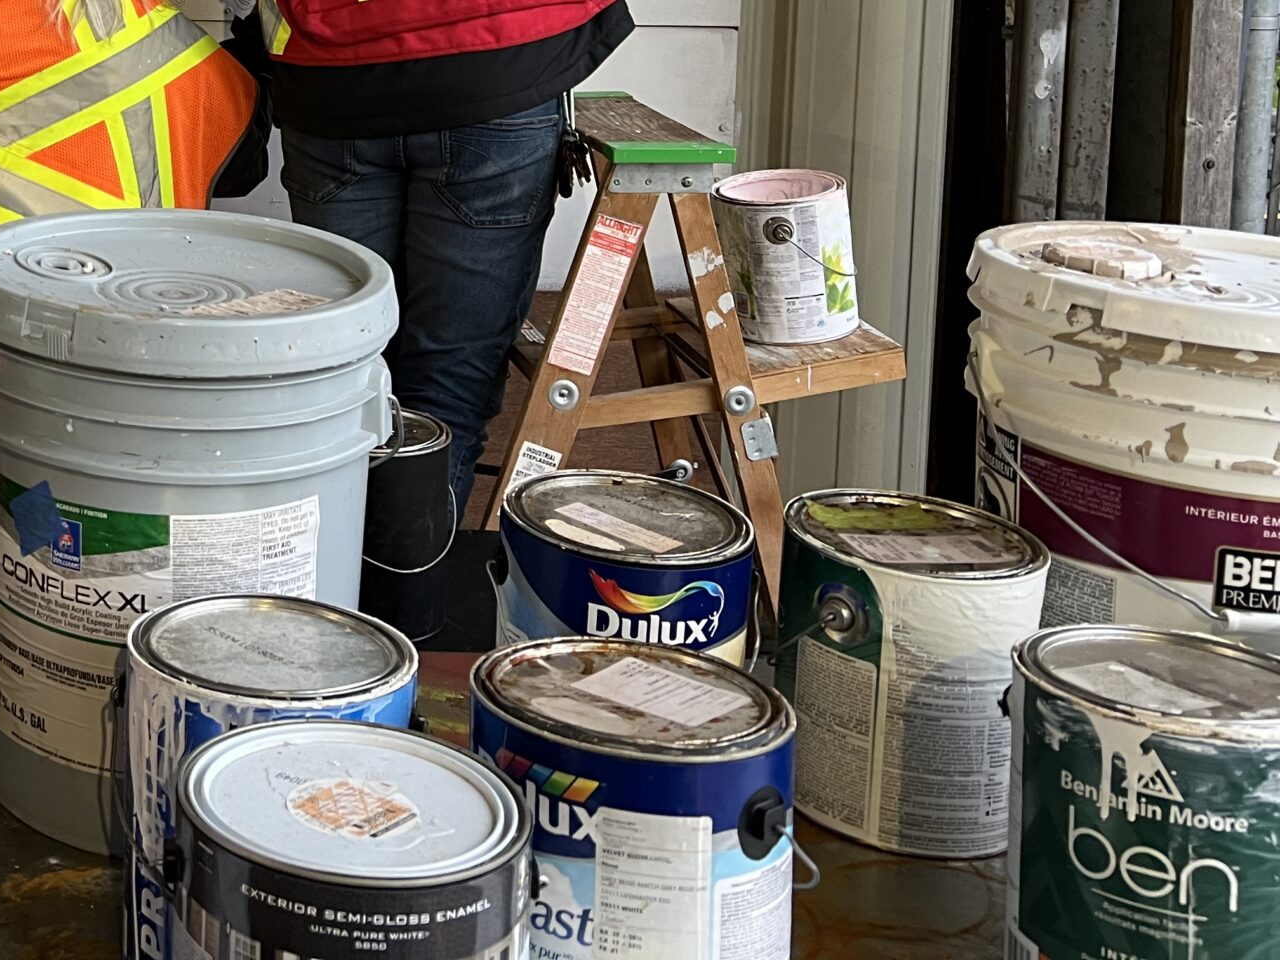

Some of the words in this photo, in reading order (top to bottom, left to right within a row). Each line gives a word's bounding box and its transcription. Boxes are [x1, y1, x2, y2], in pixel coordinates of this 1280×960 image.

[598, 215, 641, 237] ALLRIGHT
[522, 452, 557, 468] STEPLADDER
[526, 446, 556, 462] INDUSTRIAL
[1185, 505, 1259, 525] INTÉRIEUR
[262, 543, 280, 553] FIRST
[262, 547, 297, 561] TREATMENT
[2, 553, 112, 610] CONFLEX
[117, 591, 150, 614] XL
[587, 601, 709, 646] Dulux
[30, 713, 48, 734] GAL
[1170, 804, 1250, 833] Moore
[1068, 805, 1238, 913] ben
[241, 882, 318, 918] EXTERIOR
[324, 909, 430, 925] SEMI-GLOSS
[436, 897, 491, 923] ENAMEL
[310, 924, 349, 938] ULTRA
[352, 929, 385, 940] PURE
[389, 931, 427, 940] WHITE
